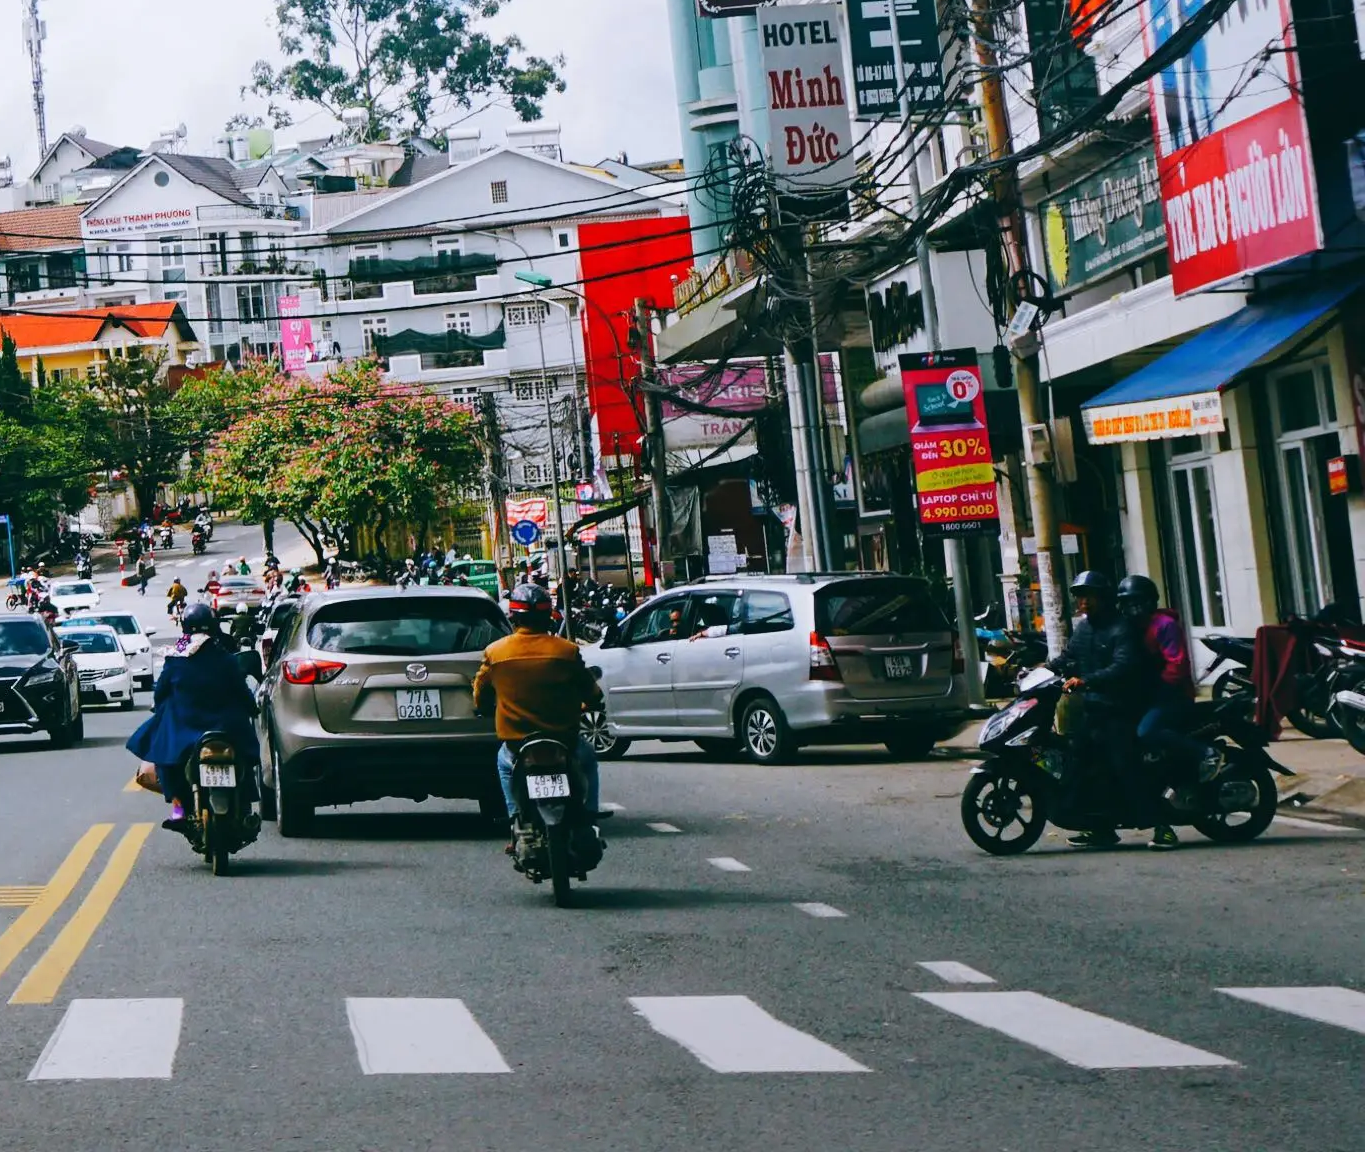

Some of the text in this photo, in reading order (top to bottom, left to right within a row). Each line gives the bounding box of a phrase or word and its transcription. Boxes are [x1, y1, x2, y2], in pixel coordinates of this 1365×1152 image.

[763, 20, 837, 47] HOTEL
[769, 64, 844, 109] Minh
[784, 121, 840, 165] Đức
[1167, 162, 1197, 263] TRẺ
[1193, 182, 1218, 252] EM
[1225, 140, 1276, 240] NGƯỜI
[1271, 128, 1308, 224] LỚN
[123, 214, 153, 223] THANH
[914, 438, 986, 459] GIẢM 30%
[922, 494, 957, 505] LAPTOP
[923, 503, 994, 518] 4.990.000Đ
[942, 522, 961, 531] 1800
[406, 691, 430, 704] 77A
[399, 704, 440, 719] 028.81
[535, 786, 565, 797] 5075
